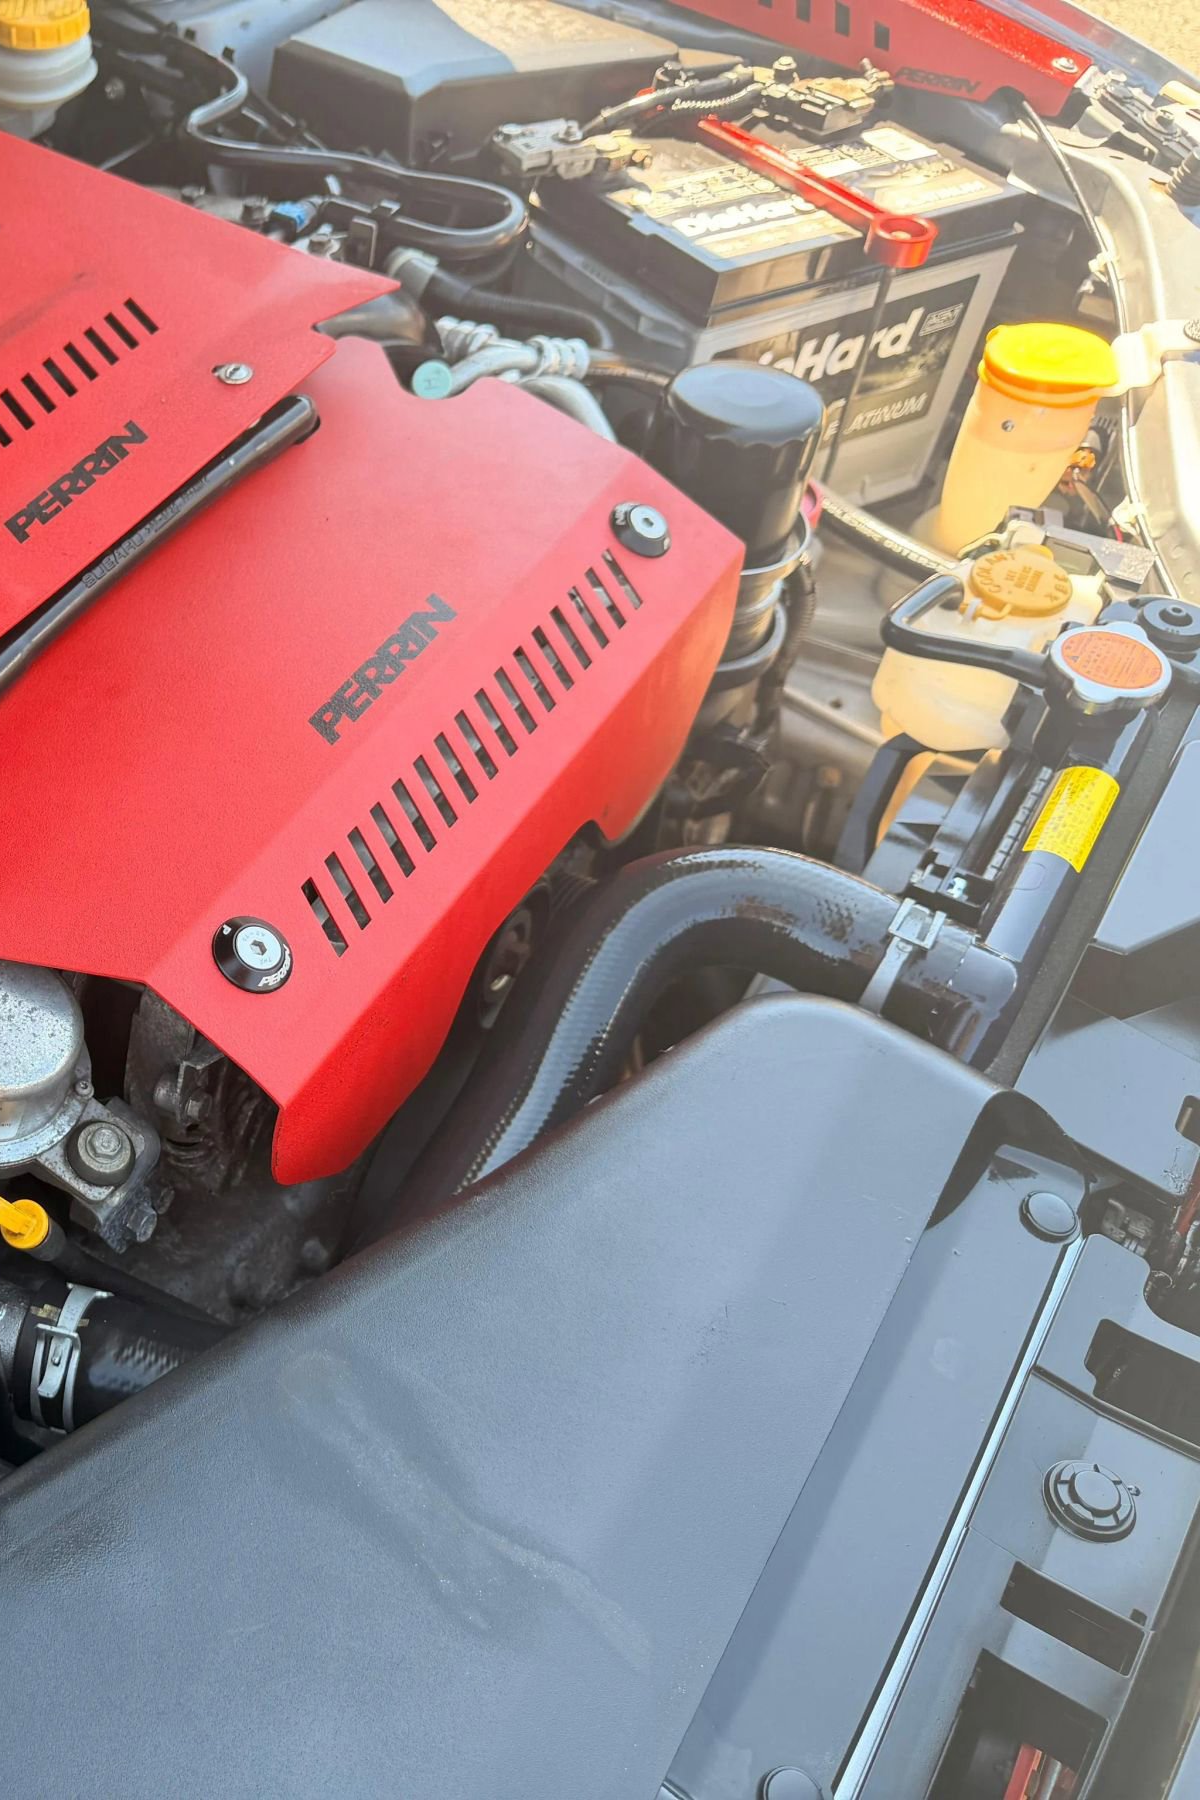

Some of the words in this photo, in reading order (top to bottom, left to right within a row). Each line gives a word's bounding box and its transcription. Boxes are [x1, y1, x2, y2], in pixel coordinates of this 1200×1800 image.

[895, 67, 982, 95] PERRIN
[758, 306, 925, 382] Hard
[4, 421, 149, 544] PERRIN
[82, 532, 145, 588] SUBARU
[308, 593, 458, 745] PERRIN
